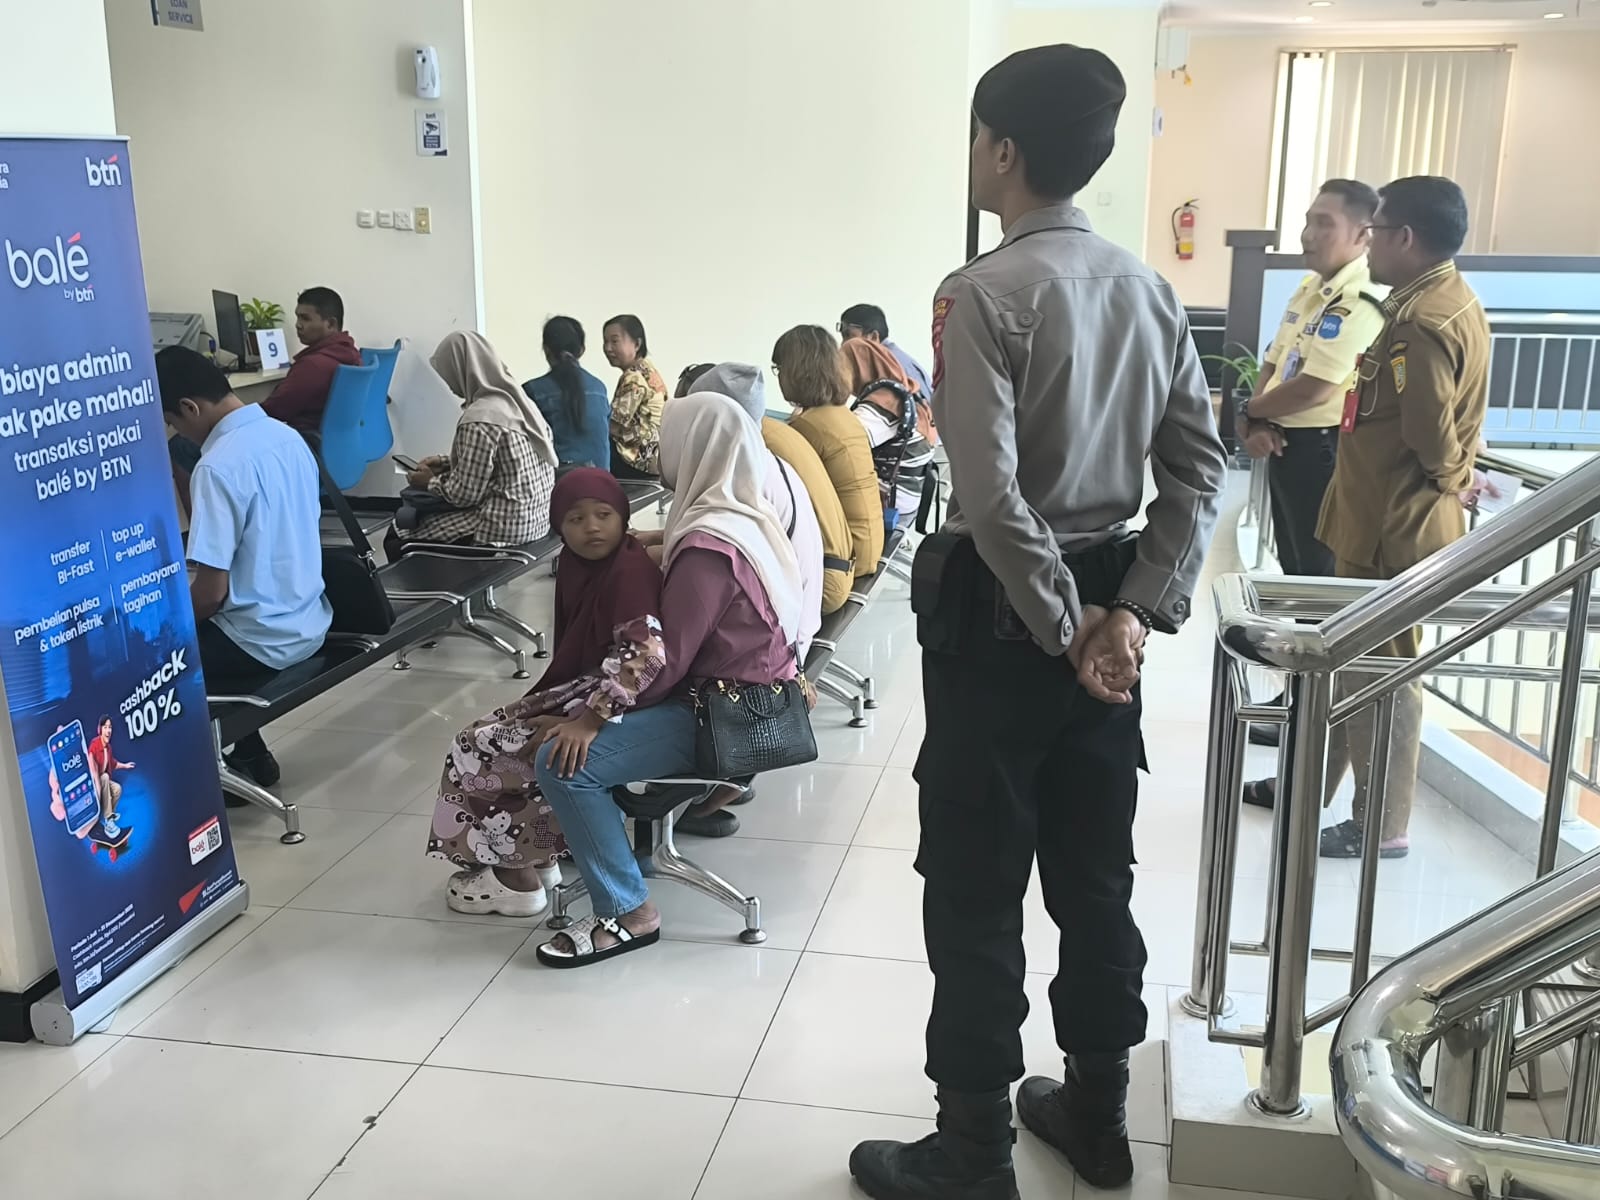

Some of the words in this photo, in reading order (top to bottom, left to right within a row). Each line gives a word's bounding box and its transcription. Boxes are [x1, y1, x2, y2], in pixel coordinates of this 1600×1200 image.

[168, 11, 194, 24] SERVICE
[85, 154, 122, 187] btn
[5, 232, 89, 288] balé
[64, 289, 74, 301] by
[75, 284, 95, 302] btn
[268, 342, 278, 357] 9
[0, 363, 60, 396] biaya
[64, 346, 132, 381] admin
[30, 398, 82, 438] pake
[86, 379, 154, 417] mahal!
[14, 431, 94, 472] transaksi
[97, 419, 142, 457] pakai
[36, 469, 71, 501] balé
[74, 467, 97, 491] by
[101, 455, 132, 481] BTN
[112, 526, 130, 543] top
[130, 522, 145, 537] up
[50, 540, 91, 566] transfer
[115, 537, 157, 562] e-wallet
[57, 559, 95, 585] BI-Fast
[121, 560, 181, 598] pembayaran
[124, 588, 162, 614] tagihan
[15, 606, 73, 646] pembelian
[73, 596, 100, 620] pulsa
[39, 638, 49, 653] &
[50, 627, 78, 648] token
[77, 613, 104, 637] listrik
[119, 648, 188, 714] cashback
[491, 733, 518, 745] Hello
